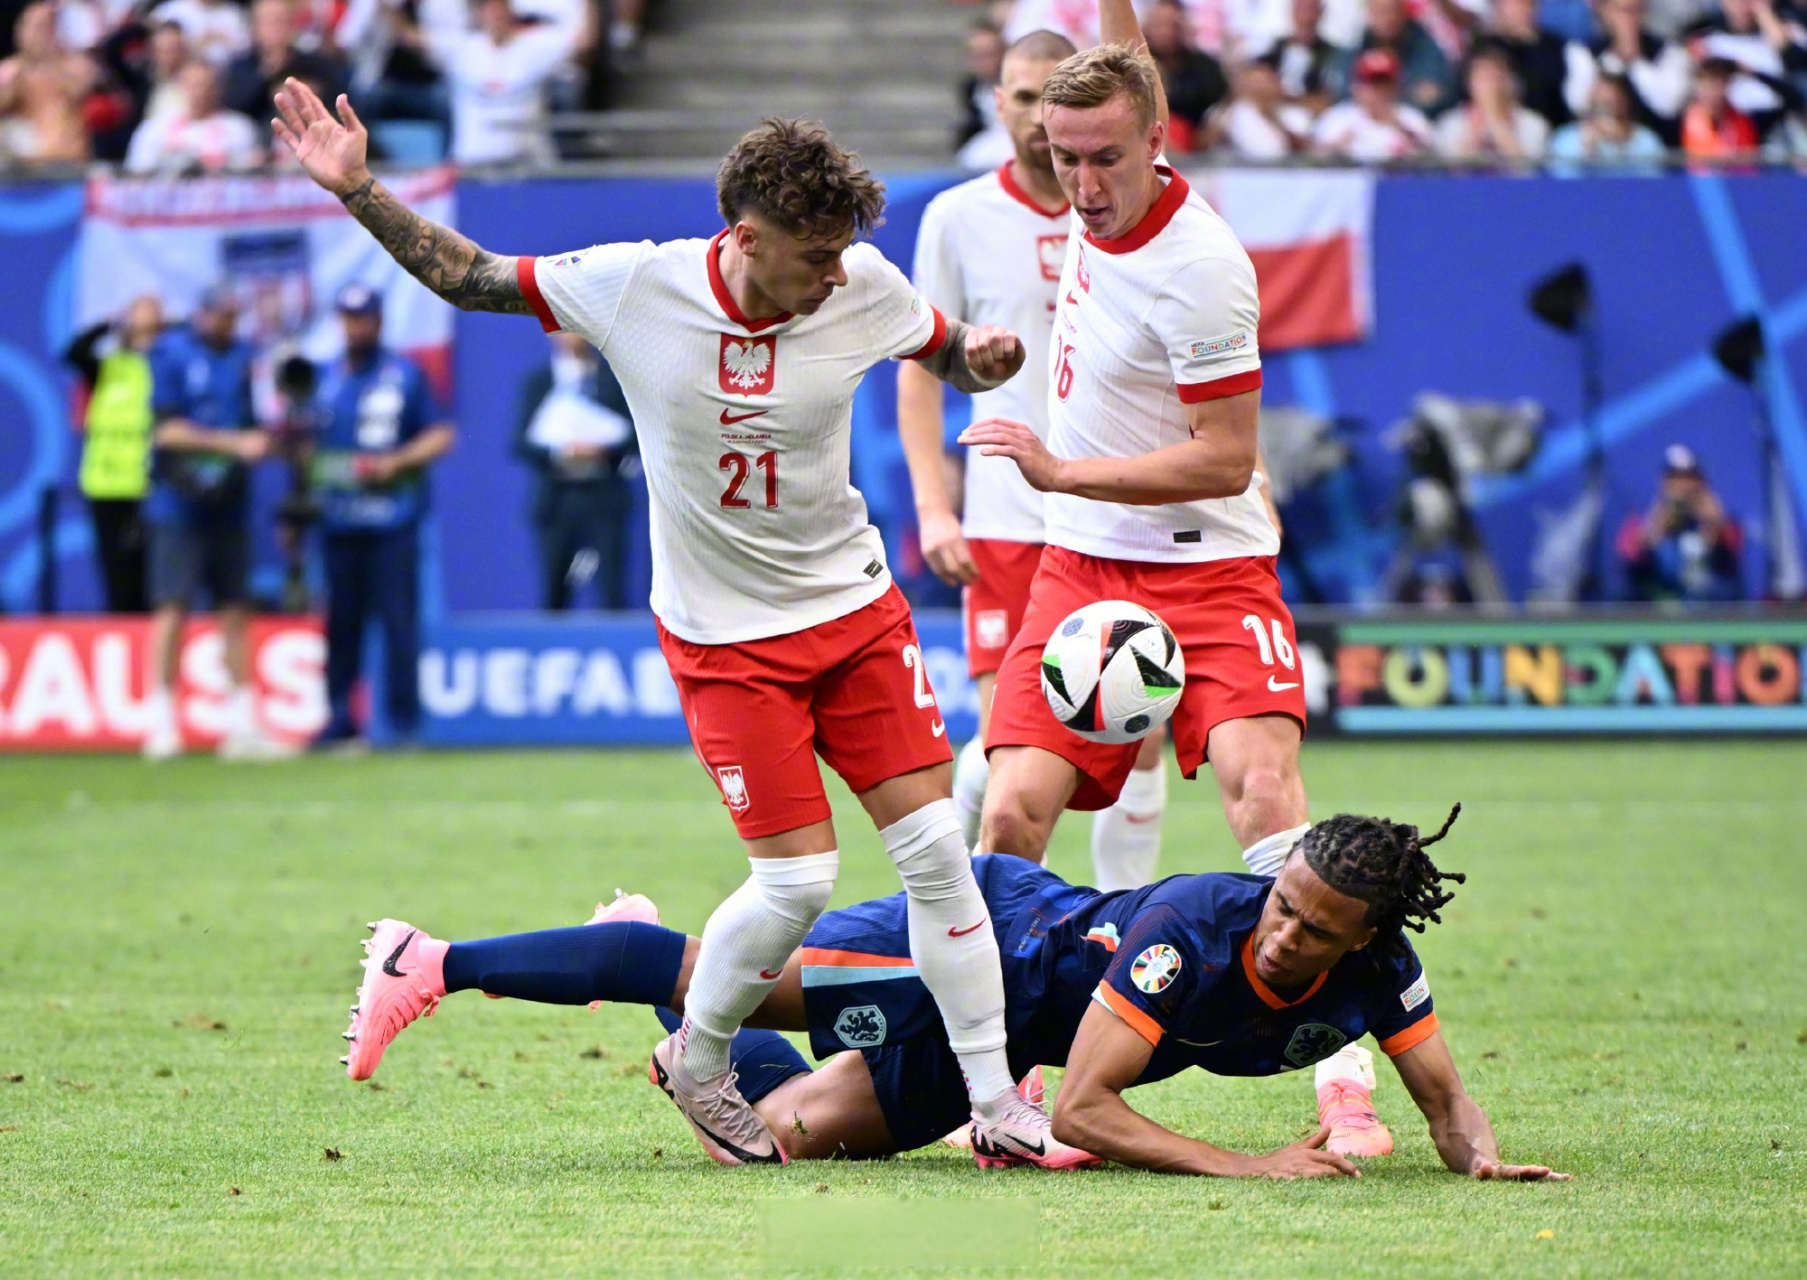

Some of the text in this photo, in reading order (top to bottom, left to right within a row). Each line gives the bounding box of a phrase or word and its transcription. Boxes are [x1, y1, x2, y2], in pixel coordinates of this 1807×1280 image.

[1191, 333, 1247, 355] FOUNDATION
[719, 450, 779, 509] 21
[1242, 614, 1295, 670] 16
[0, 632, 330, 737] AUSS
[1336, 642, 1807, 707] FOUNDATIO
